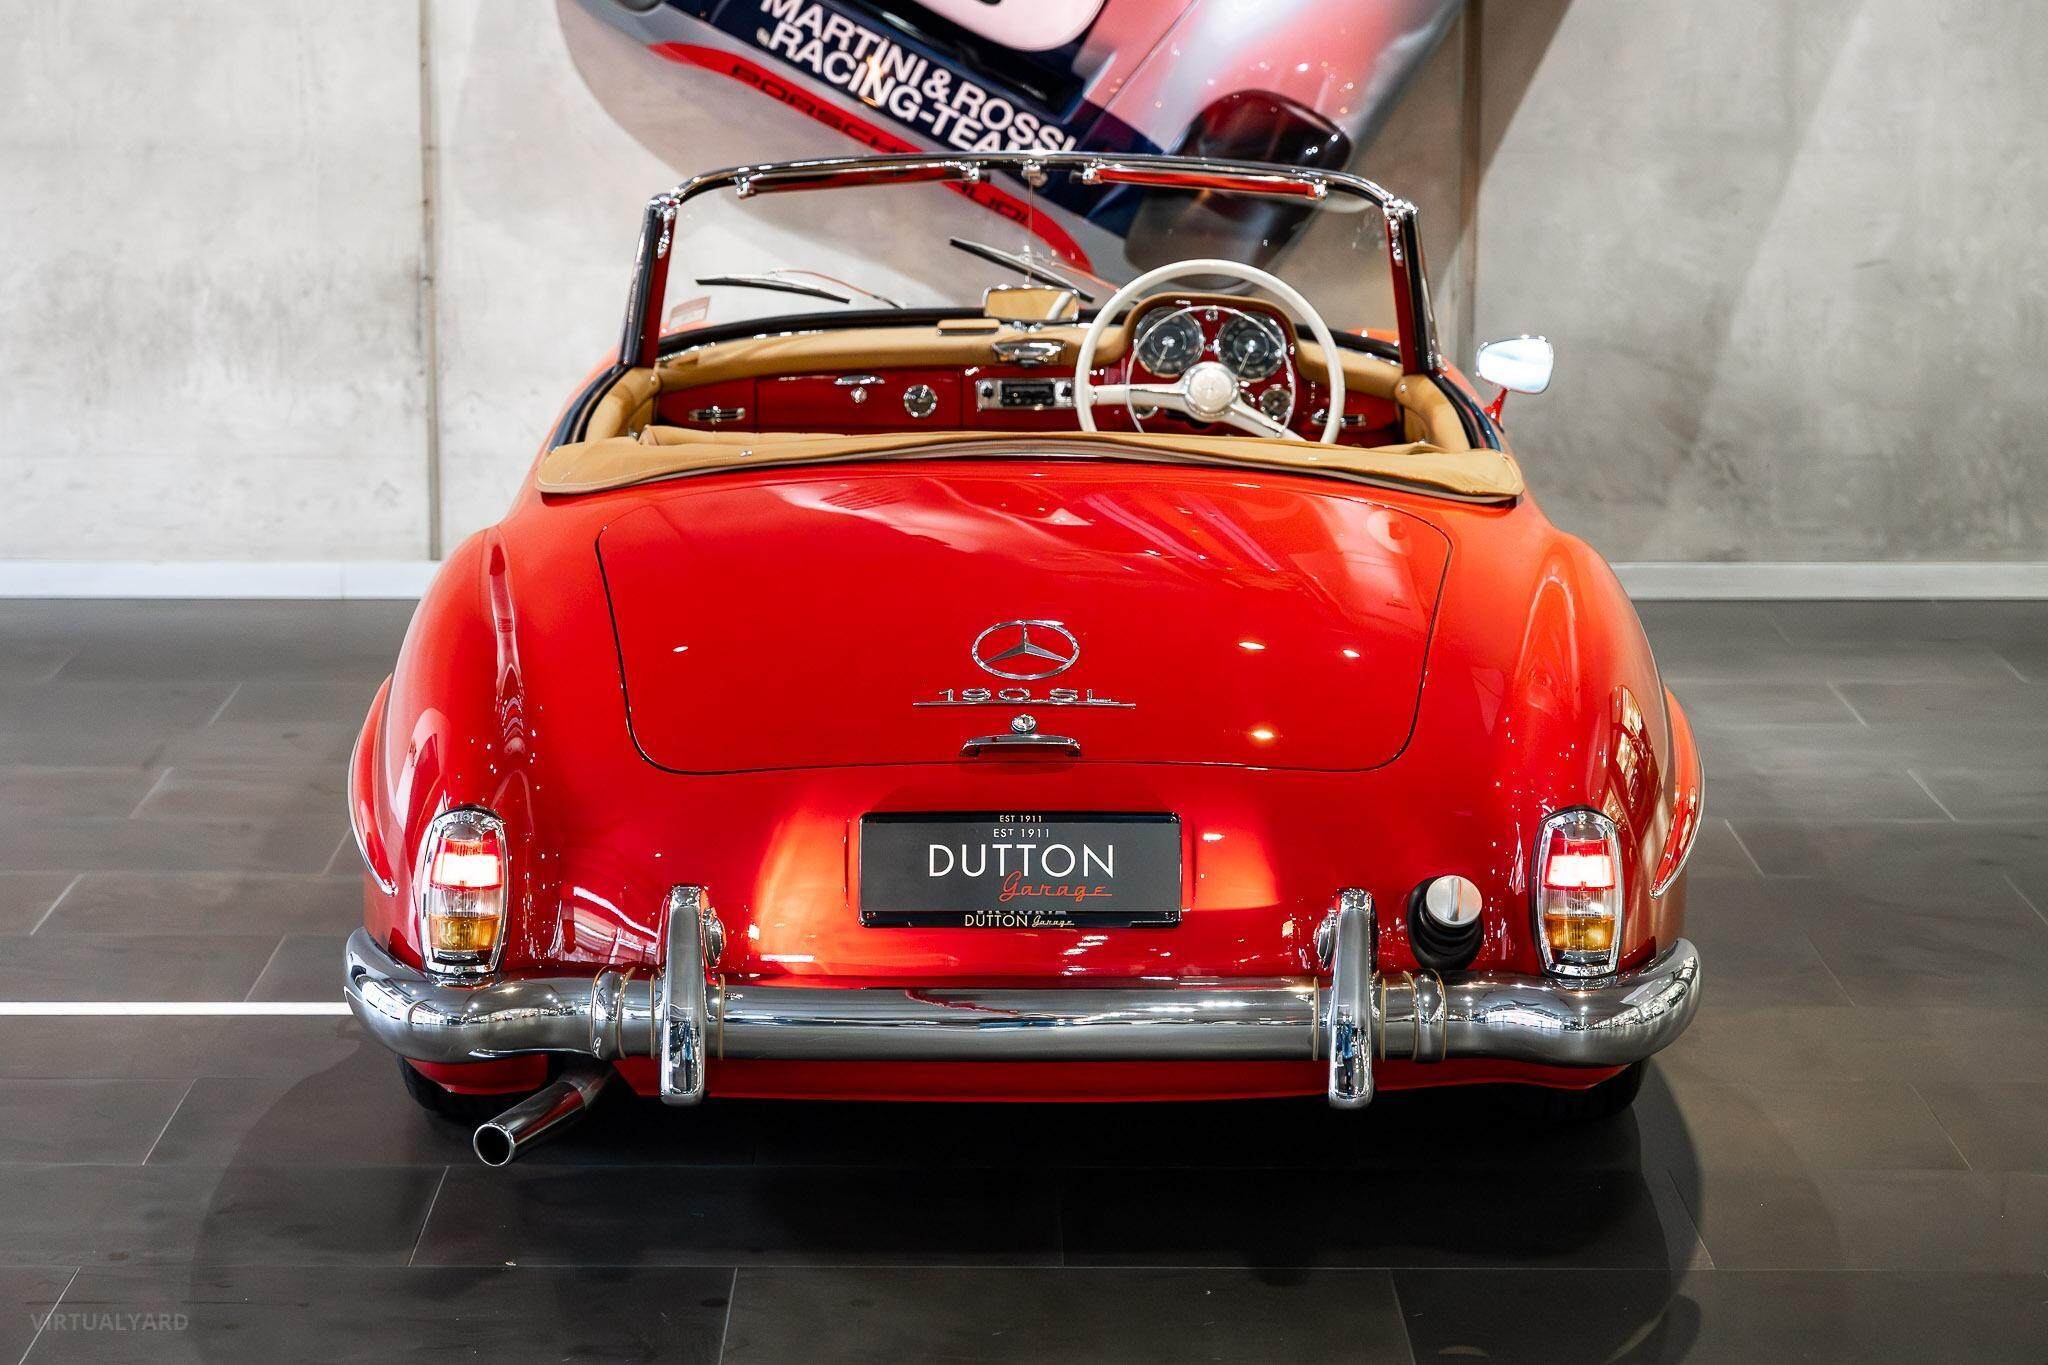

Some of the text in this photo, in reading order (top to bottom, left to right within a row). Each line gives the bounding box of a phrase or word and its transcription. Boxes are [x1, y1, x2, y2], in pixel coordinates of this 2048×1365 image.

[760, 0, 929, 88] MARTINI
[768, 20, 1042, 152] RACING-TEA
[939, 688, 1119, 704] 190 SL
[999, 815, 1043, 823] EST 1911
[993, 828, 1050, 838] EST 1911
[929, 844, 1114, 878] DUTTON
[999, 871, 1113, 902] Garage
[965, 914, 1075, 928] DUTTON Garage
